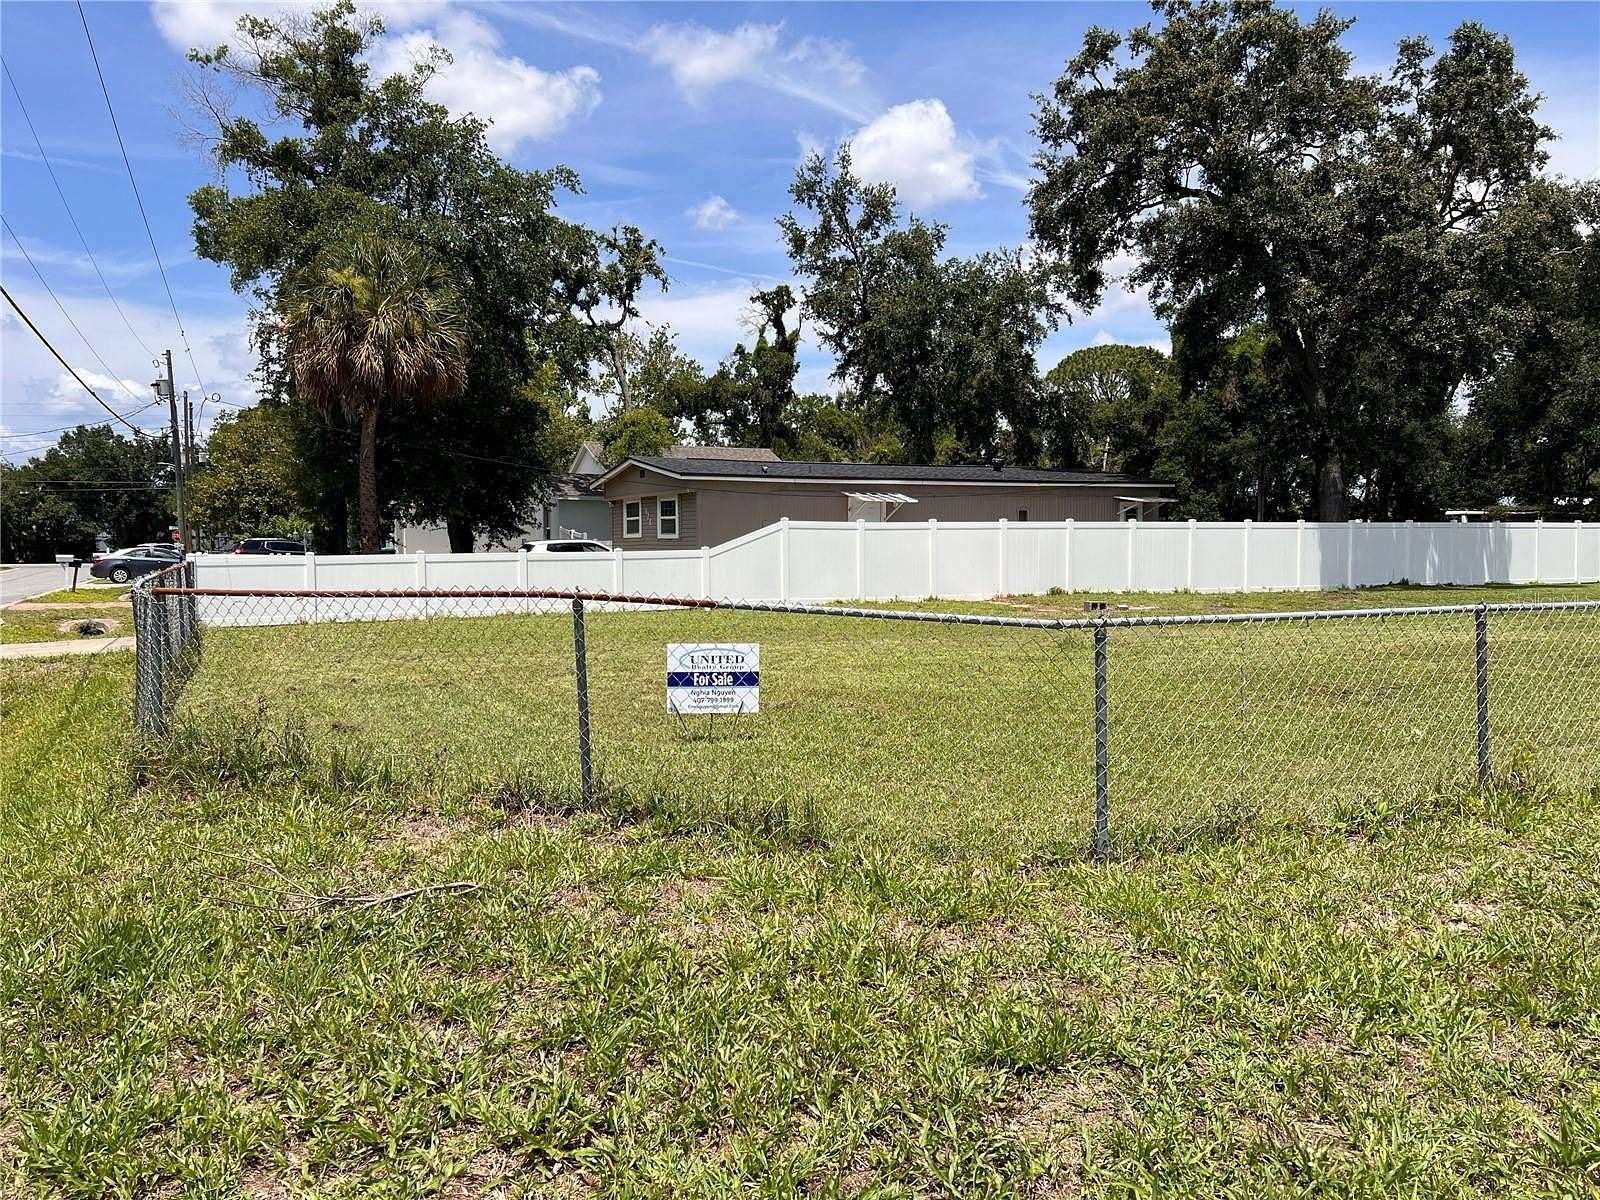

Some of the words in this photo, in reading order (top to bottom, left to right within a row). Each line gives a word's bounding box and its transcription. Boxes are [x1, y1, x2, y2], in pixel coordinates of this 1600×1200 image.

[690, 655, 745, 664] UNITED
[693, 672, 710, 686] For
[711, 672, 734, 686] Sale
[711, 689, 736, 697] Nguyen
